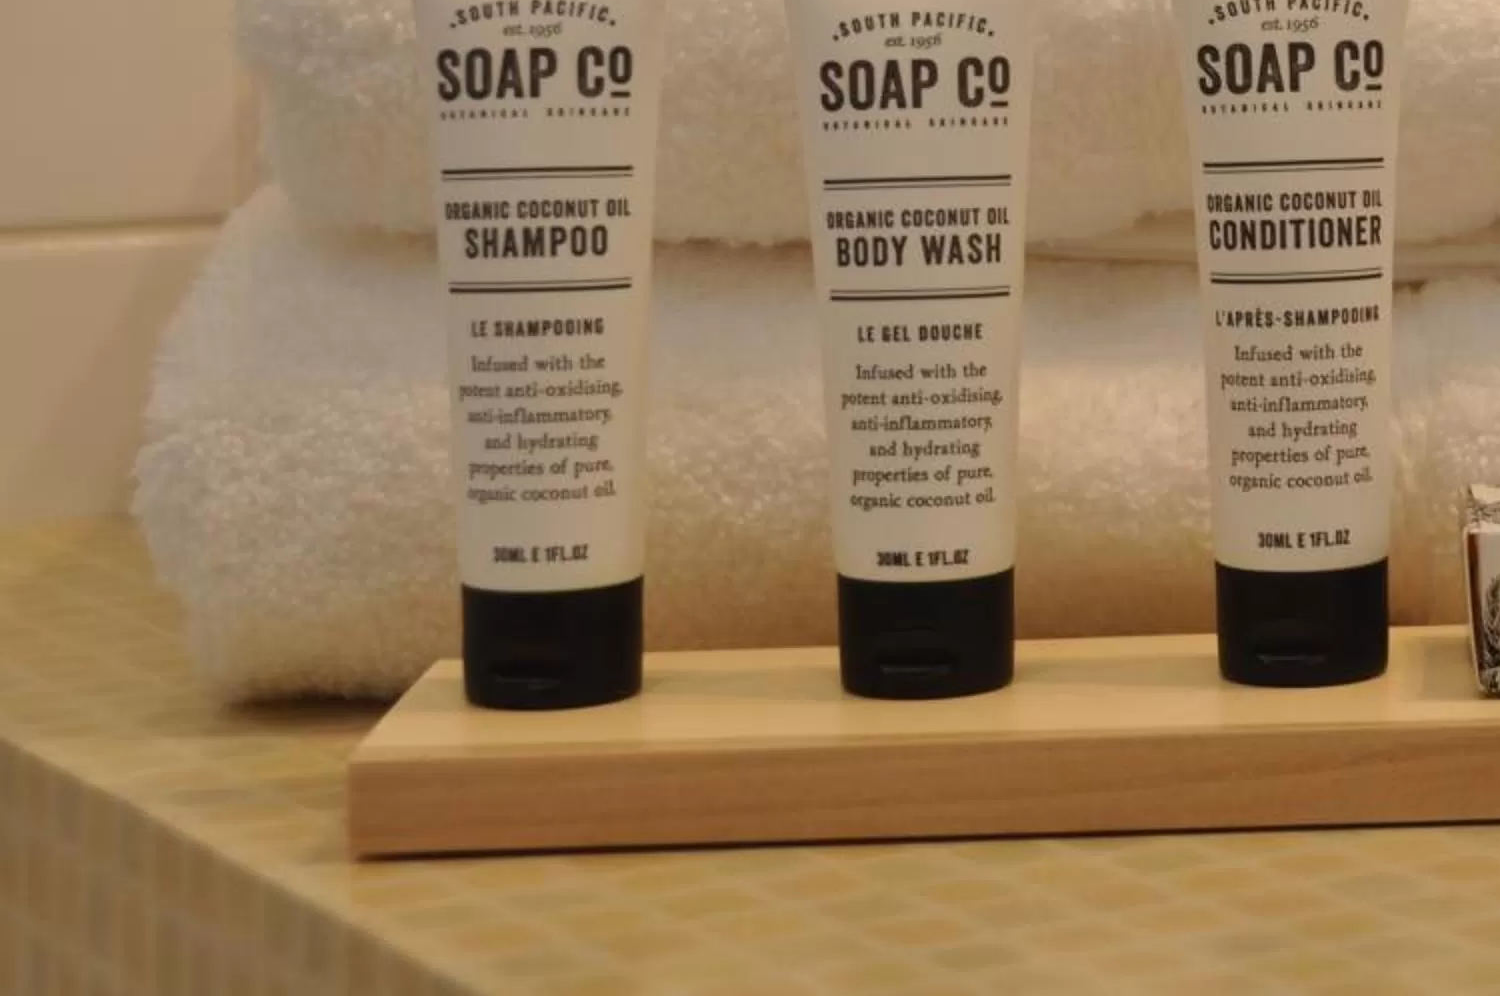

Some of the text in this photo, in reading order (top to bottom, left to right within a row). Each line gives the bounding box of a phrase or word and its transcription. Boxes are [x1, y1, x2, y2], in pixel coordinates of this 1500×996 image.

[436, 46, 558, 103] SOAP
[1196, 40, 1316, 97] SOAP
[818, 57, 939, 113] SOAP
[444, 197, 631, 221] ORGANIC COCONUT OIL
[1206, 188, 1383, 214] ORGANIC COCONUT OIL
[825, 205, 1010, 231] ORGANIC COCONUT OIL
[463, 223, 608, 260] SHAMPOO
[1208, 213, 1382, 252] CONDITIONER
[835, 232, 1001, 268] BODY WASH
[470, 316, 605, 338] LE SHAMPOOING
[857, 322, 983, 344] LE GEL DOUCHE
[470, 352, 606, 373] Infused with the
[1233, 341, 1364, 363] Infused with the
[855, 360, 988, 381] Infused with the
[1219, 371, 1266, 392] potent
[840, 391, 888, 411] potent
[1247, 418, 1359, 441] and hydrating
[483, 431, 600, 454] and hydrating
[868, 438, 982, 460] and hydrating
[1230, 446, 1310, 469] properties
[1312, 443, 1333, 463] of
[852, 465, 930, 488] properties
[932, 463, 953, 482] of
[1228, 471, 1282, 493] organic
[1284, 471, 1351, 489] coconut
[849, 491, 902, 512] organic
[905, 491, 972, 509] coconut
